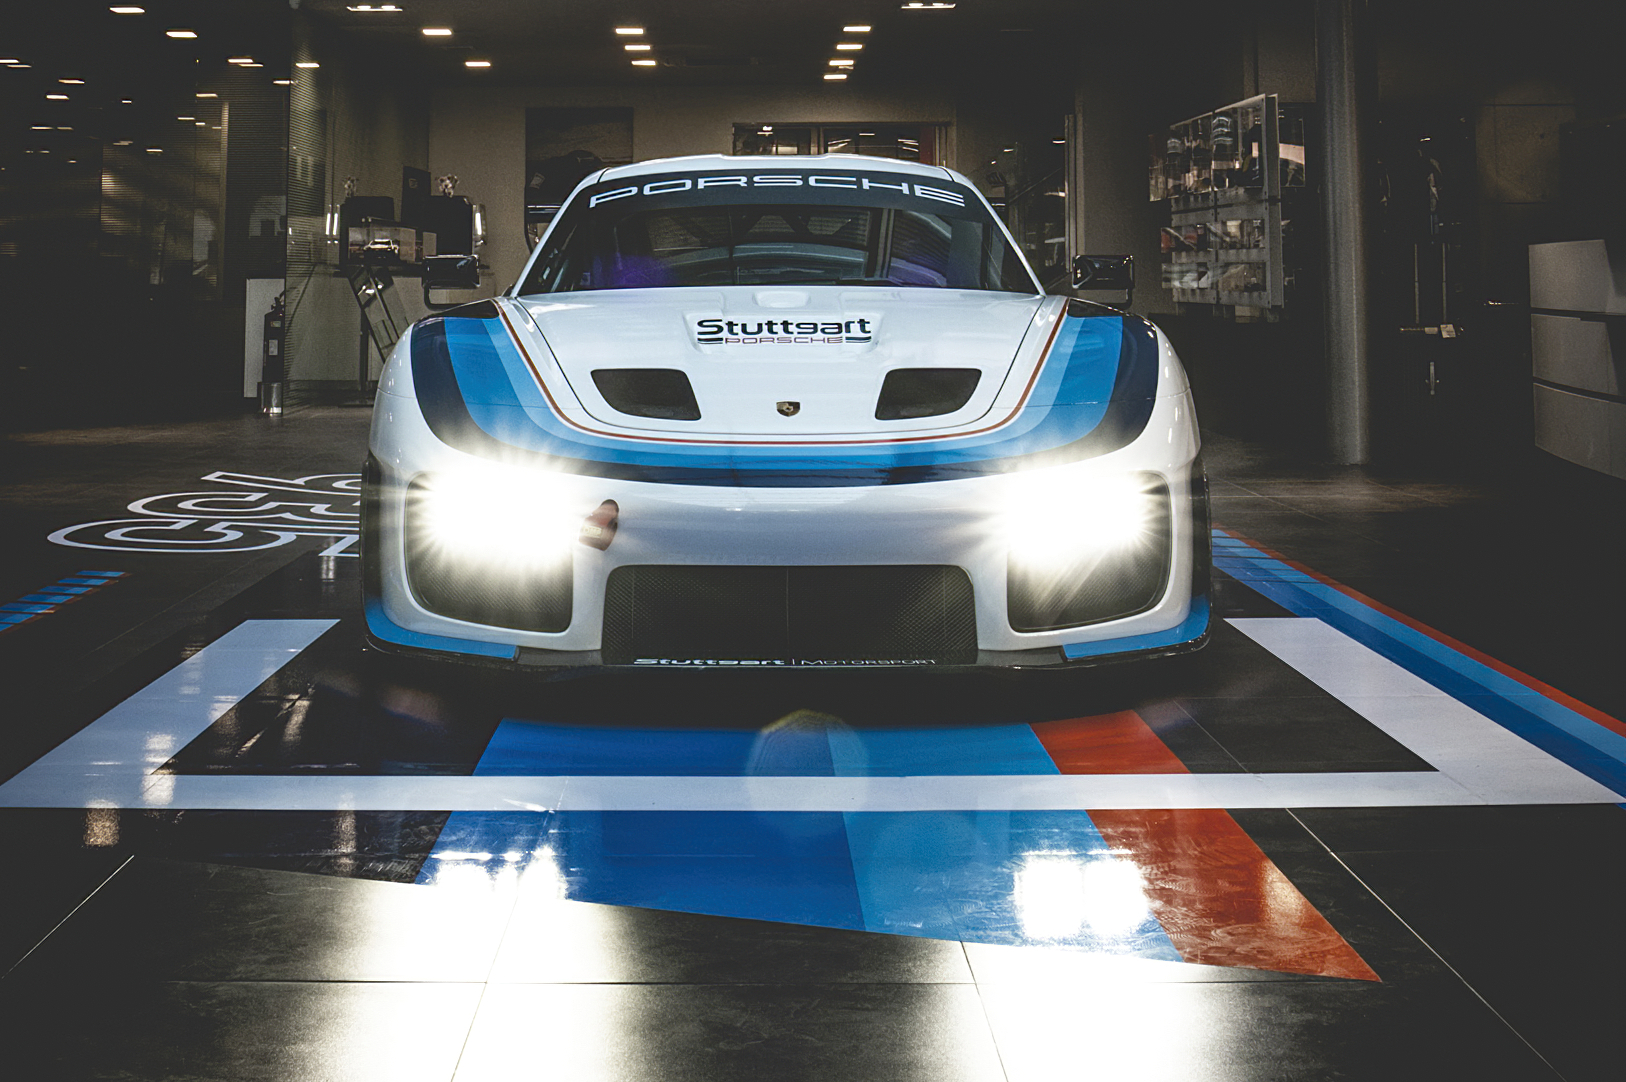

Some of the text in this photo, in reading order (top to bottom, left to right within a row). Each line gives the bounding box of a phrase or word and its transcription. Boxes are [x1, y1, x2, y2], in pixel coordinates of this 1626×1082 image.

[589, 175, 965, 208] PORSCHE
[697, 318, 871, 336] Stuttgart
[725, 336, 843, 344] PORSCHE
